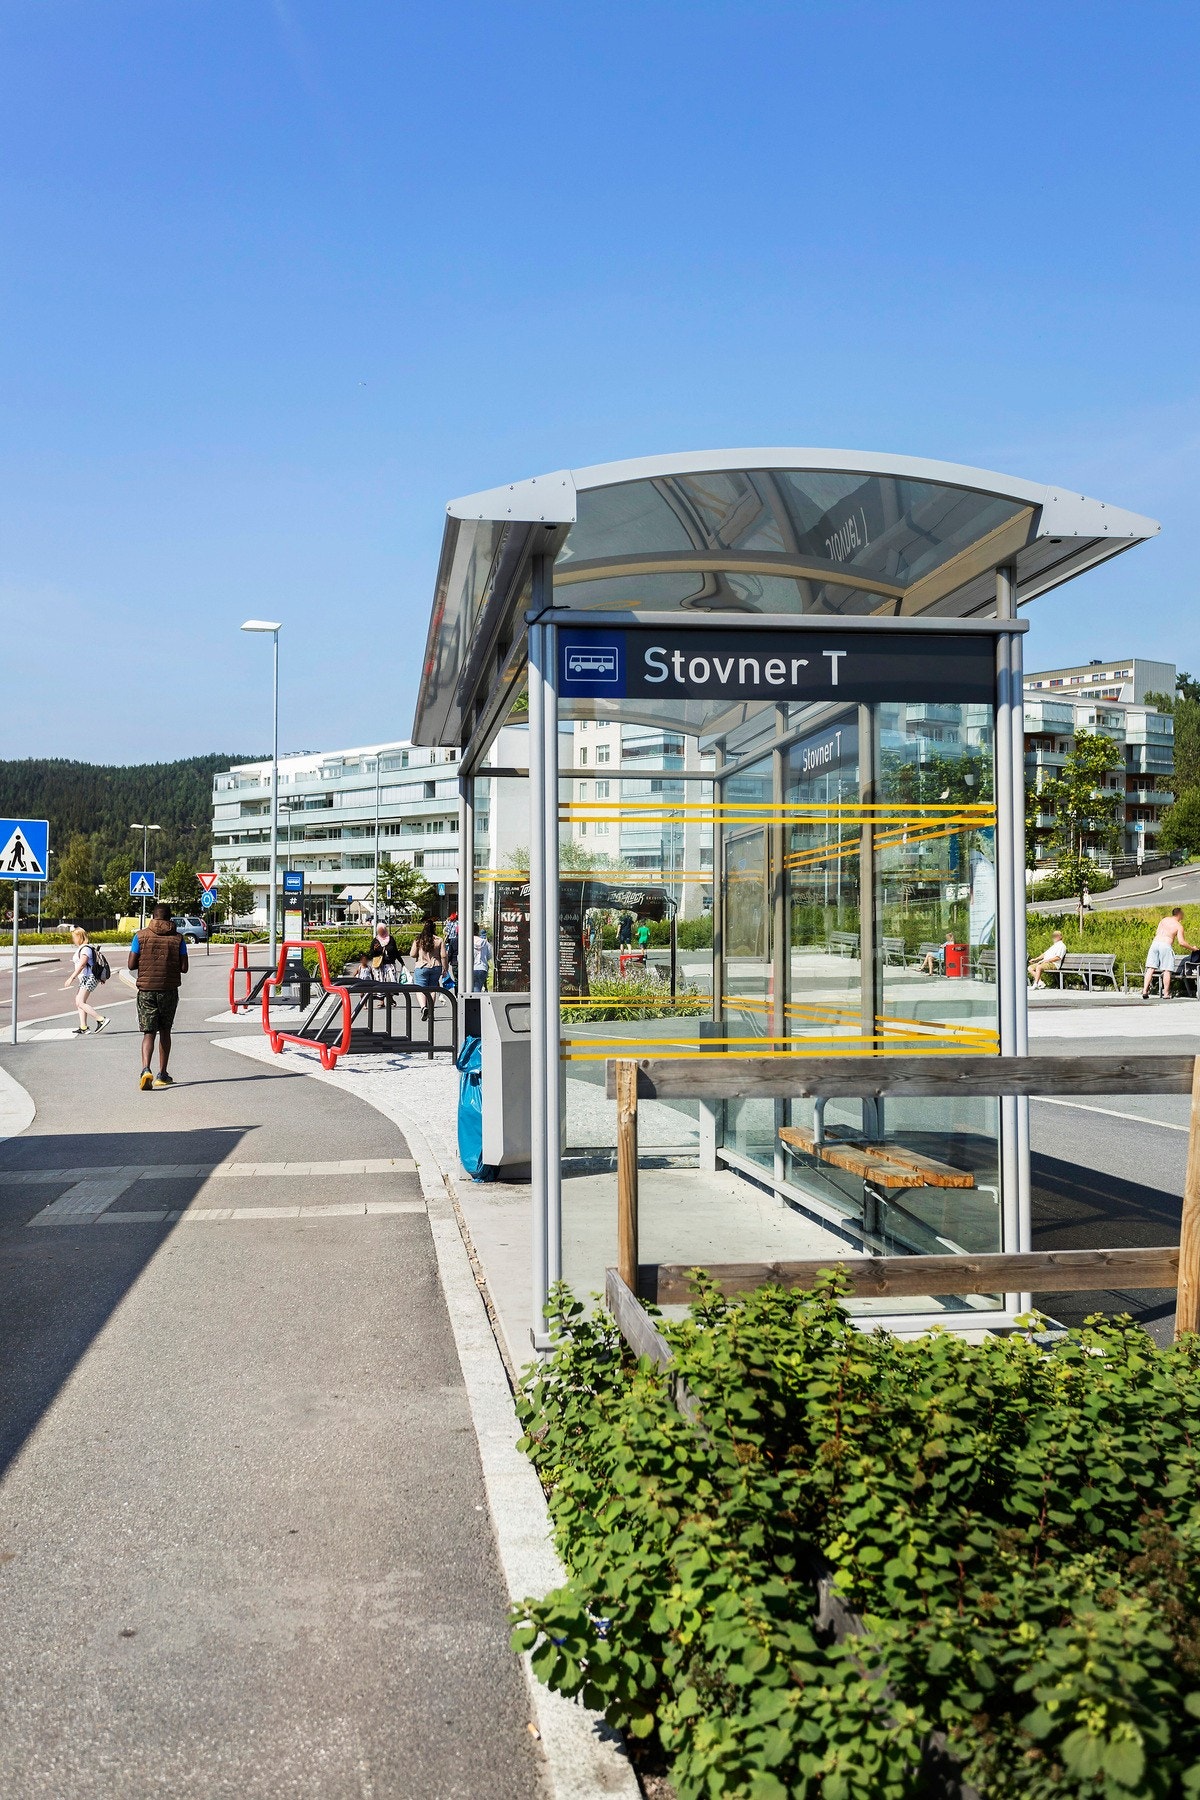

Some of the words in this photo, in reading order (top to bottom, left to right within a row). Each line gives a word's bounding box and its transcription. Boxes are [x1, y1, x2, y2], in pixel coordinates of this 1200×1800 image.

[643, 647, 809, 685] Stovner
[822, 651, 847, 685] T
[802, 742, 834, 772] Stovner
[835, 731, 842, 757] T
[501, 911, 523, 923] KISS
